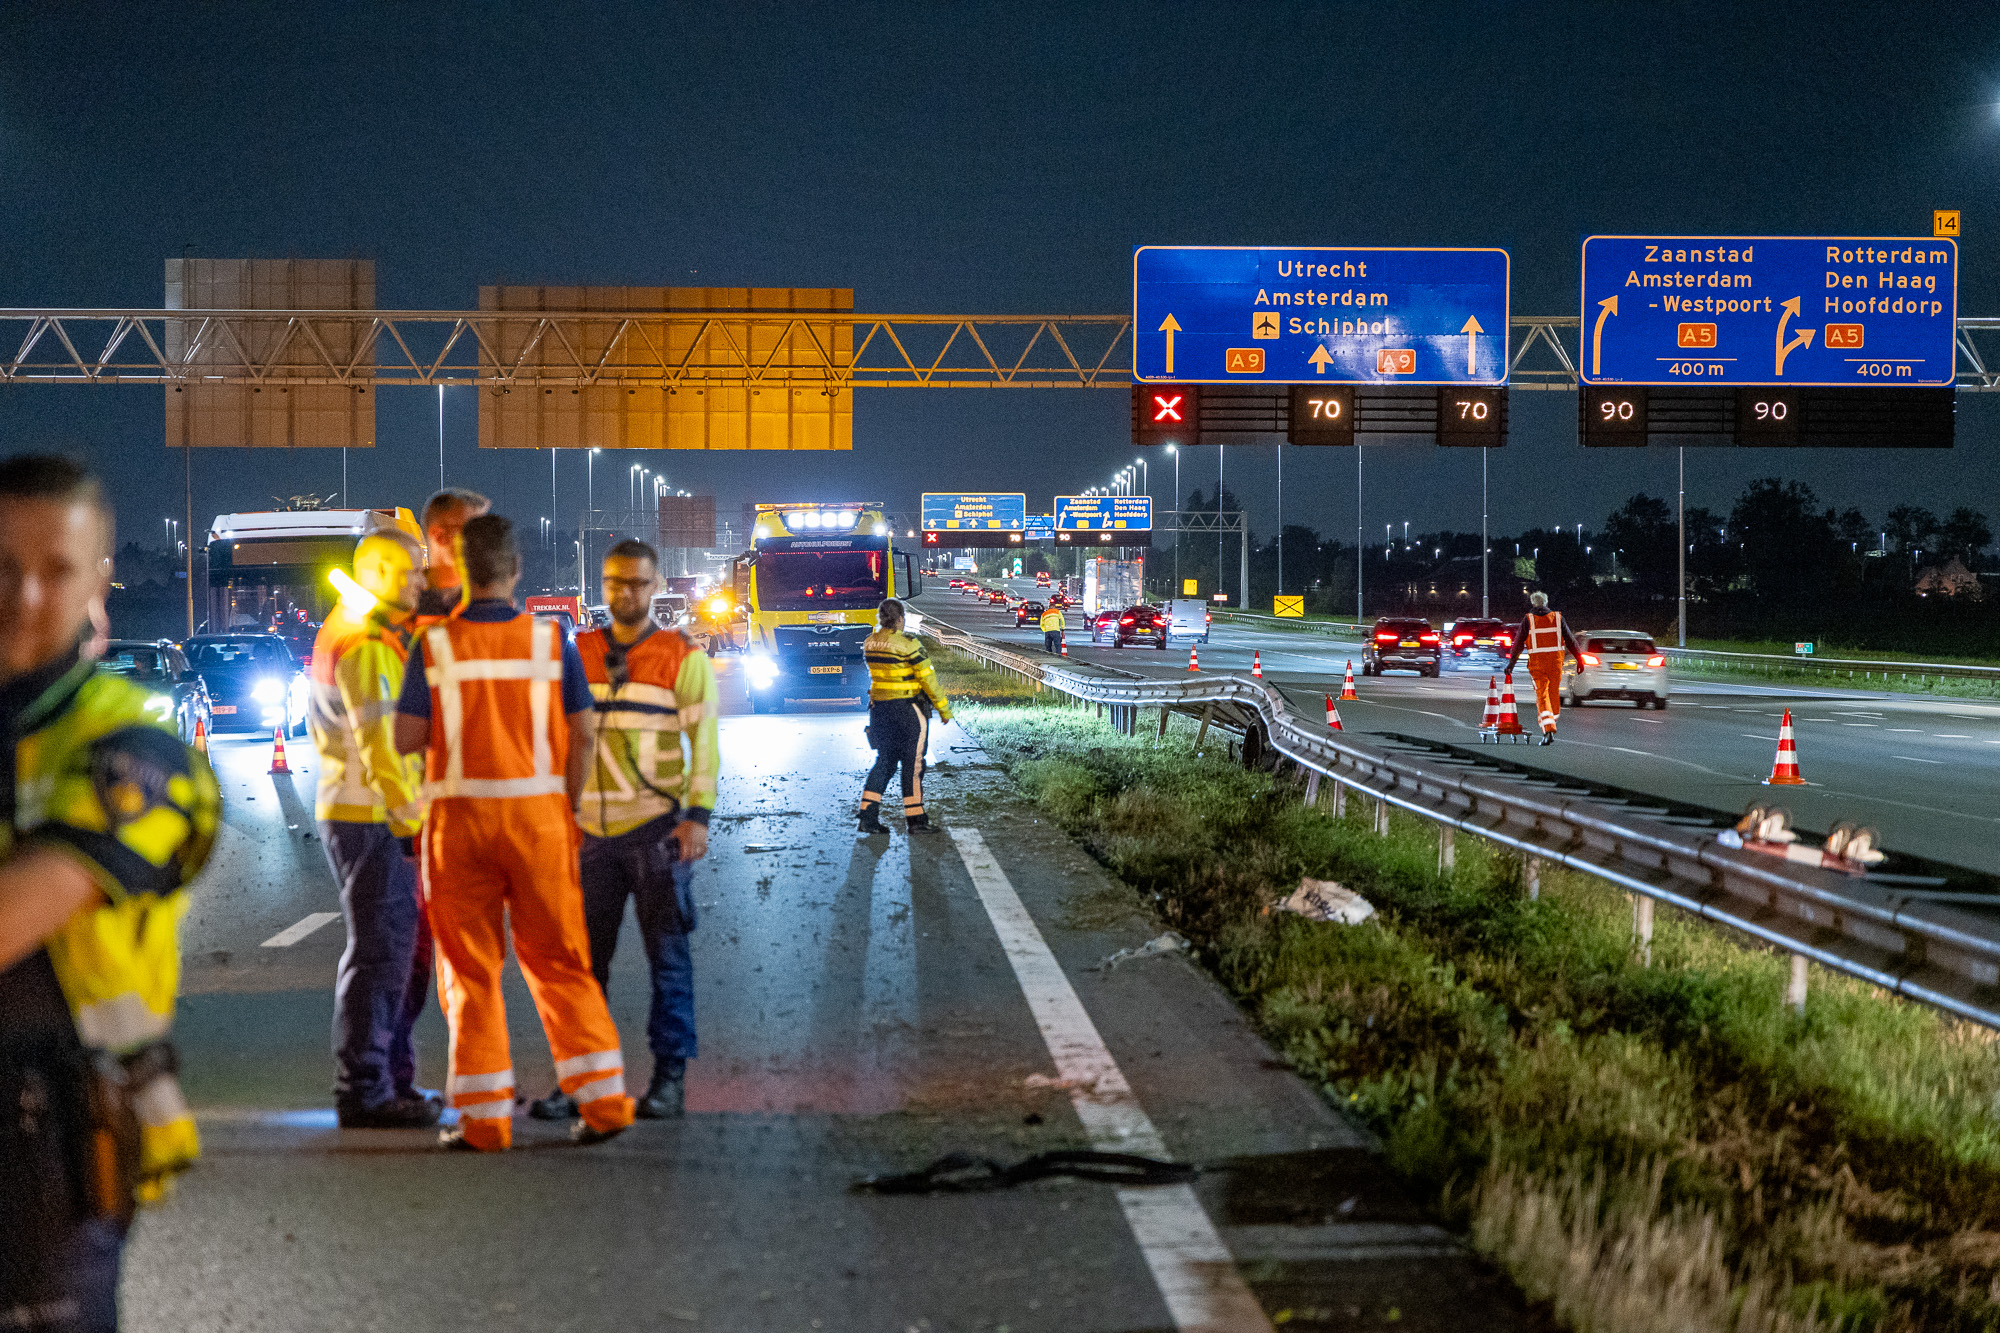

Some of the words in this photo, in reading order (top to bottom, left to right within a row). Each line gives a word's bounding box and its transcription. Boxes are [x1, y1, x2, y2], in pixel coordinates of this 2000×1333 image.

[1936, 216, 1957, 231] 14
[1644, 245, 1754, 263] Zaanstad
[1826, 246, 1949, 264] Rotterdam
[1278, 260, 1368, 278] Utrecht
[1625, 270, 1752, 288] Amsterdam
[1826, 271, 1868, 289] Den
[1879, 271, 1936, 294] Haag
[1254, 288, 1389, 307] Amsterdam
[1824, 296, 1943, 318] Hoofddorp
[1288, 316, 1391, 336] Schiphol
[1682, 328, 1712, 343] A5
[1830, 328, 1860, 344] A5
[1230, 353, 1260, 369] A9
[1381, 353, 1411, 370] A9
[1668, 362, 1707, 377] 400
[1708, 365, 1724, 377] m
[1856, 363, 1894, 377] 400
[1896, 366, 1912, 377] m
[1308, 400, 1341, 419] 70
[1456, 401, 1488, 420] 70
[1600, 401, 1634, 421] 90
[1754, 401, 1788, 421] 90
[1009, 534, 1022, 542] 70
[1059, 533, 1071, 541] 90
[1100, 533, 1112, 541] 90
